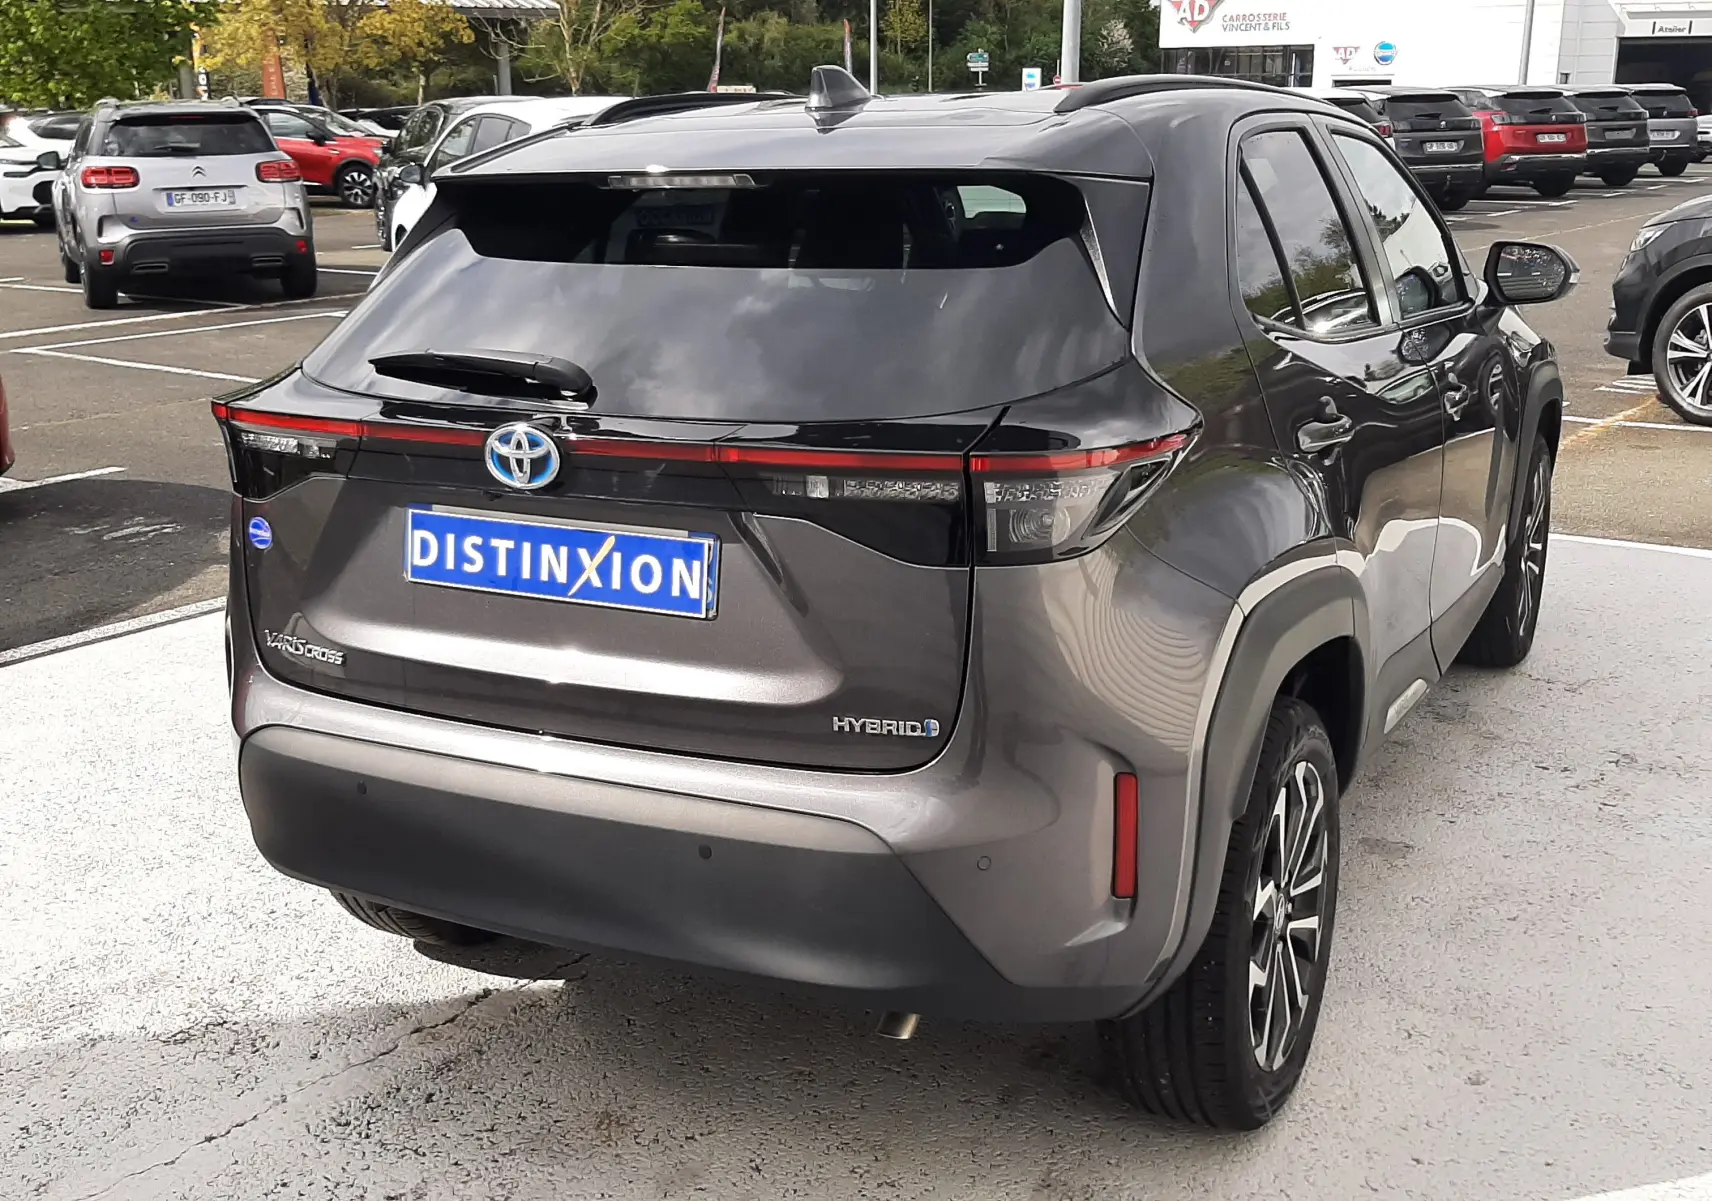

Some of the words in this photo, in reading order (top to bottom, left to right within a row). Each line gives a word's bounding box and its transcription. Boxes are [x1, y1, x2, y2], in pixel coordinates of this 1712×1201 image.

[1177, 0, 1210, 21] AD
[1222, 12, 1287, 23] CARROSSERIE
[1222, 22, 1262, 32] VINCENT
[1263, 22, 1270, 31] &
[1272, 21, 1290, 31] FILS
[1657, 25, 1687, 33] Atelier
[174, 192, 227, 204] GF-090-FJ
[412, 529, 701, 600] DISTINXION
[264, 629, 306, 655] YARIS
[305, 644, 344, 665] CROSS
[833, 716, 922, 736] HYBRID
